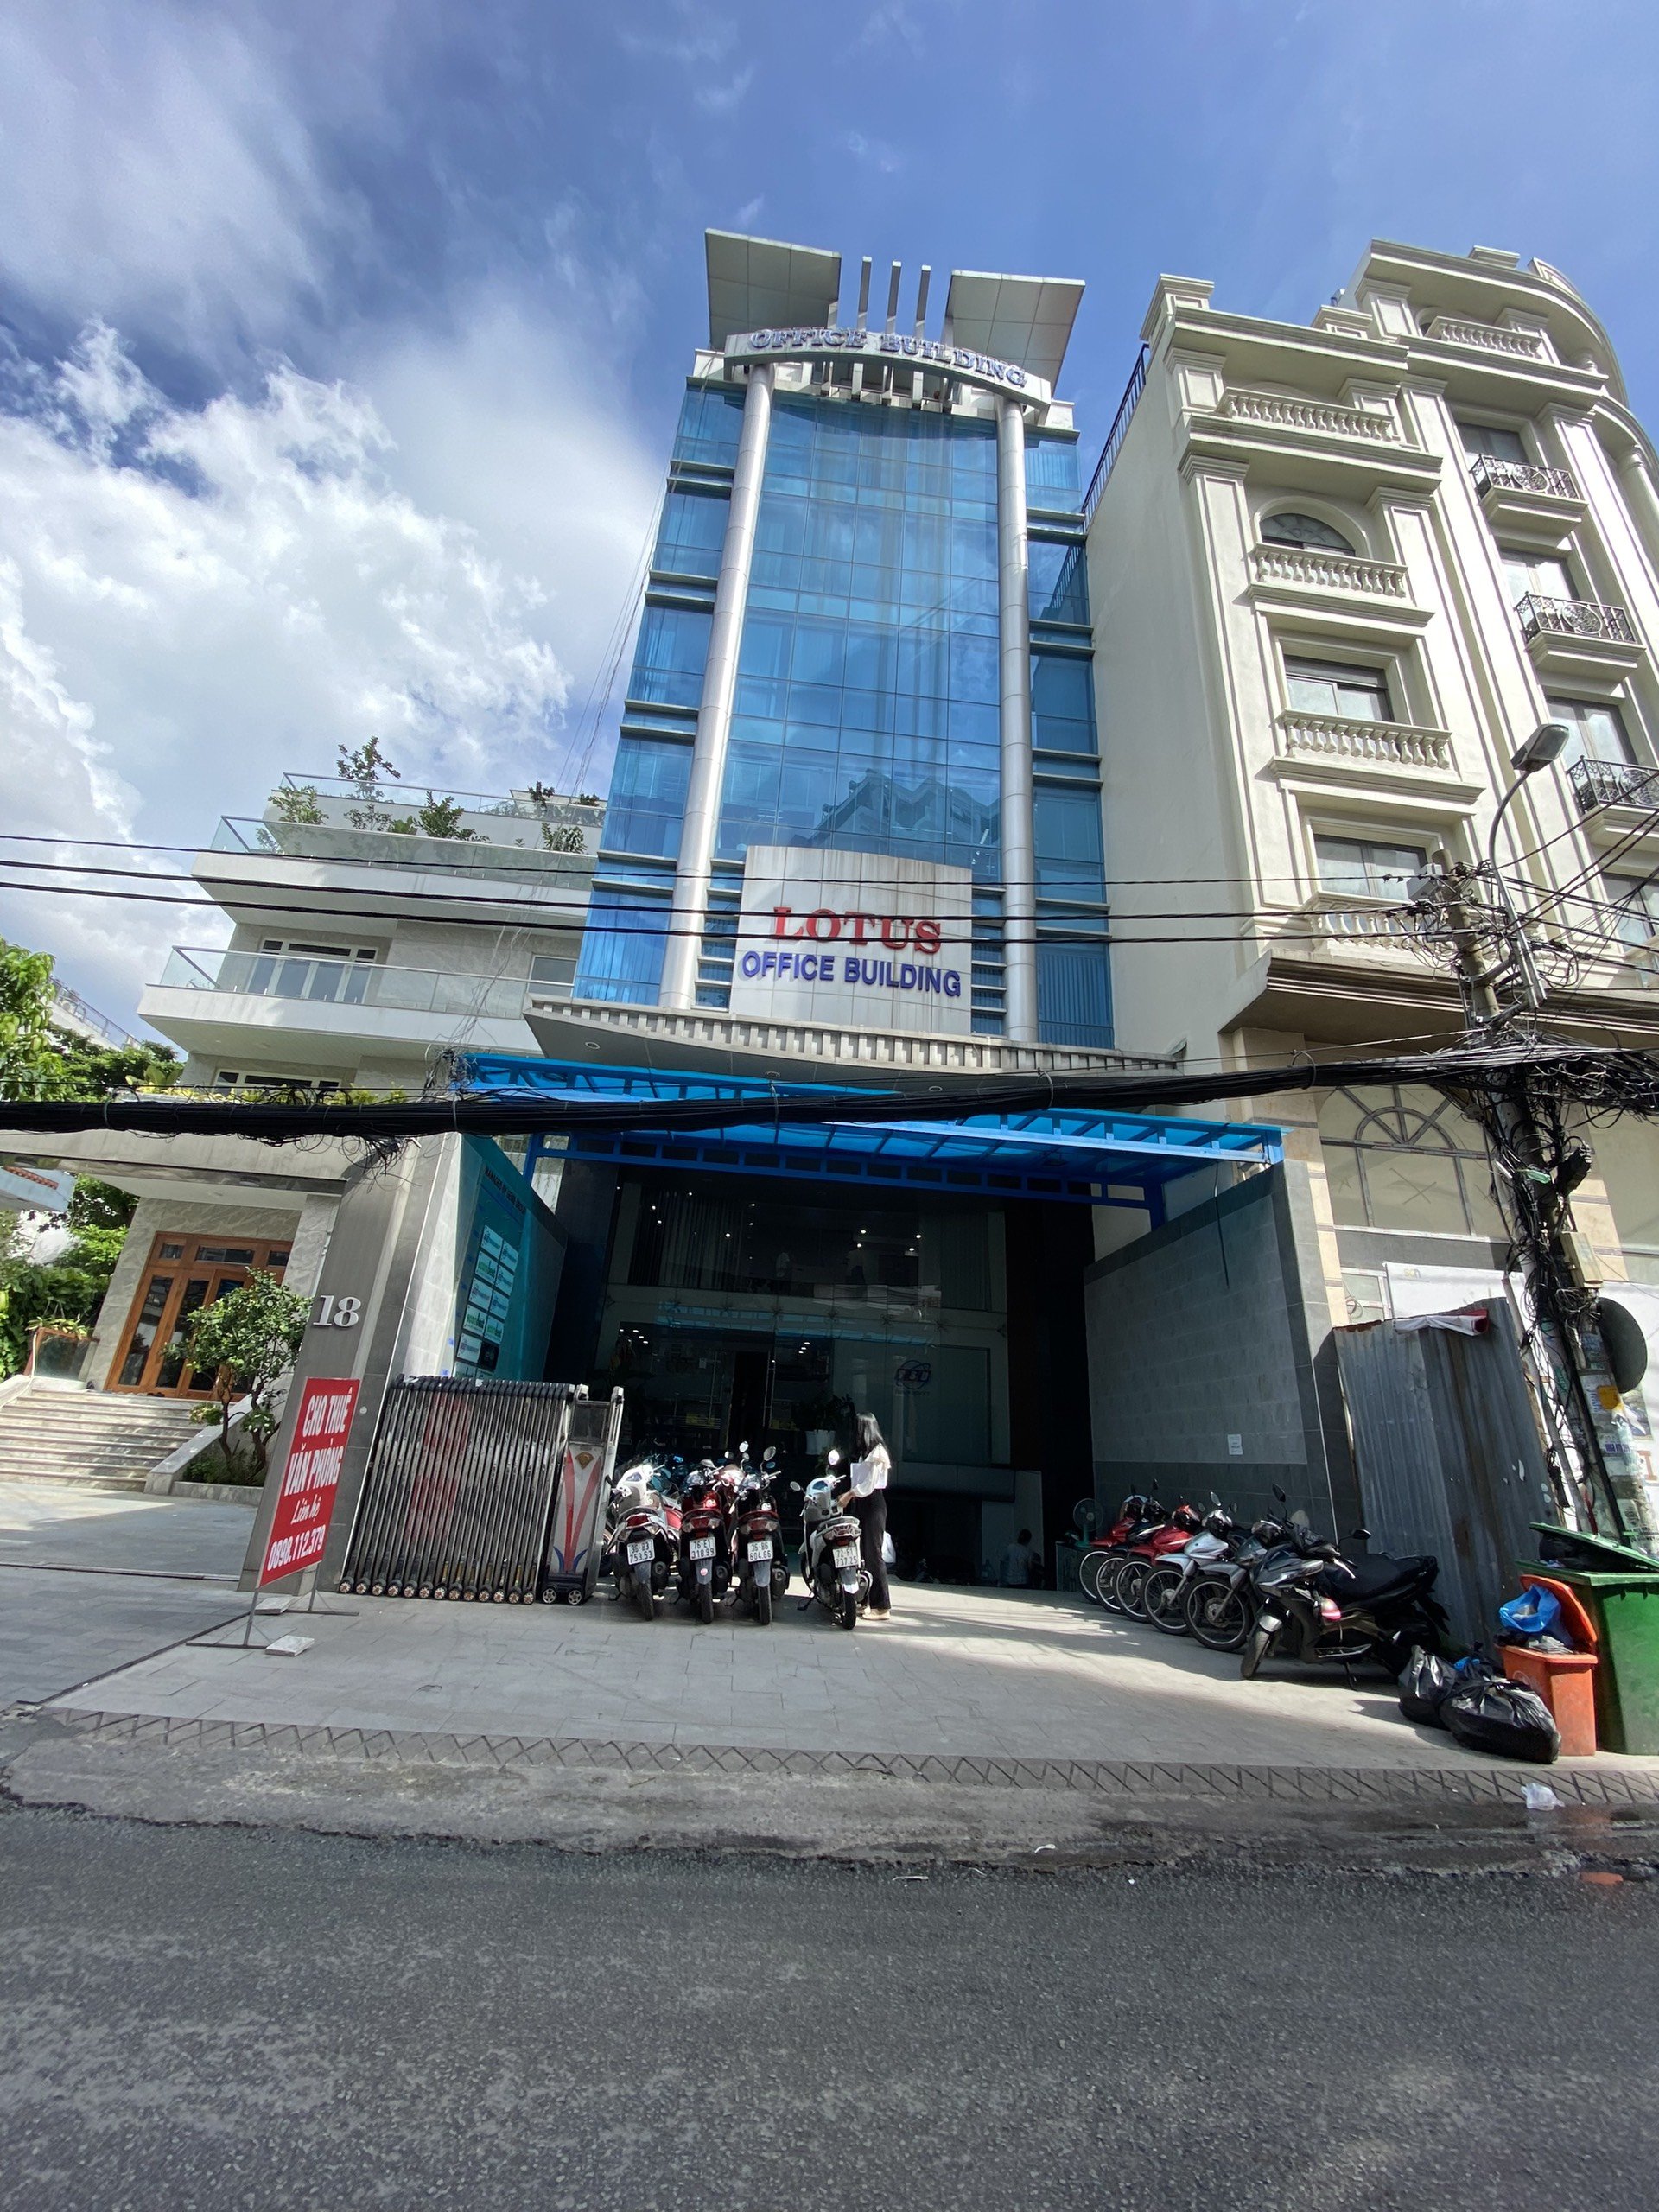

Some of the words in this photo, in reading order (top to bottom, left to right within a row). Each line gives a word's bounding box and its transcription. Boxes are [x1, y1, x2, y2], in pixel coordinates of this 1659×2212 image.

[749, 327, 868, 351] OFFICE
[879, 332, 1028, 389] BUILDING
[773, 906, 942, 955] LOTUS
[742, 950, 835, 982] OFFICE
[844, 957, 961, 998] BUILDING
[311, 1294, 361, 1328] 18
[302, 1395, 327, 1437] CHO
[324, 1386, 353, 1434] THUÊ
[284, 1443, 312, 1497] VĂN
[306, 1438, 344, 1491] PHÒNG
[290, 1497, 311, 1524] Liên
[308, 1494, 322, 1522] hệ
[267, 1524, 326, 1571] 0898.112.379
